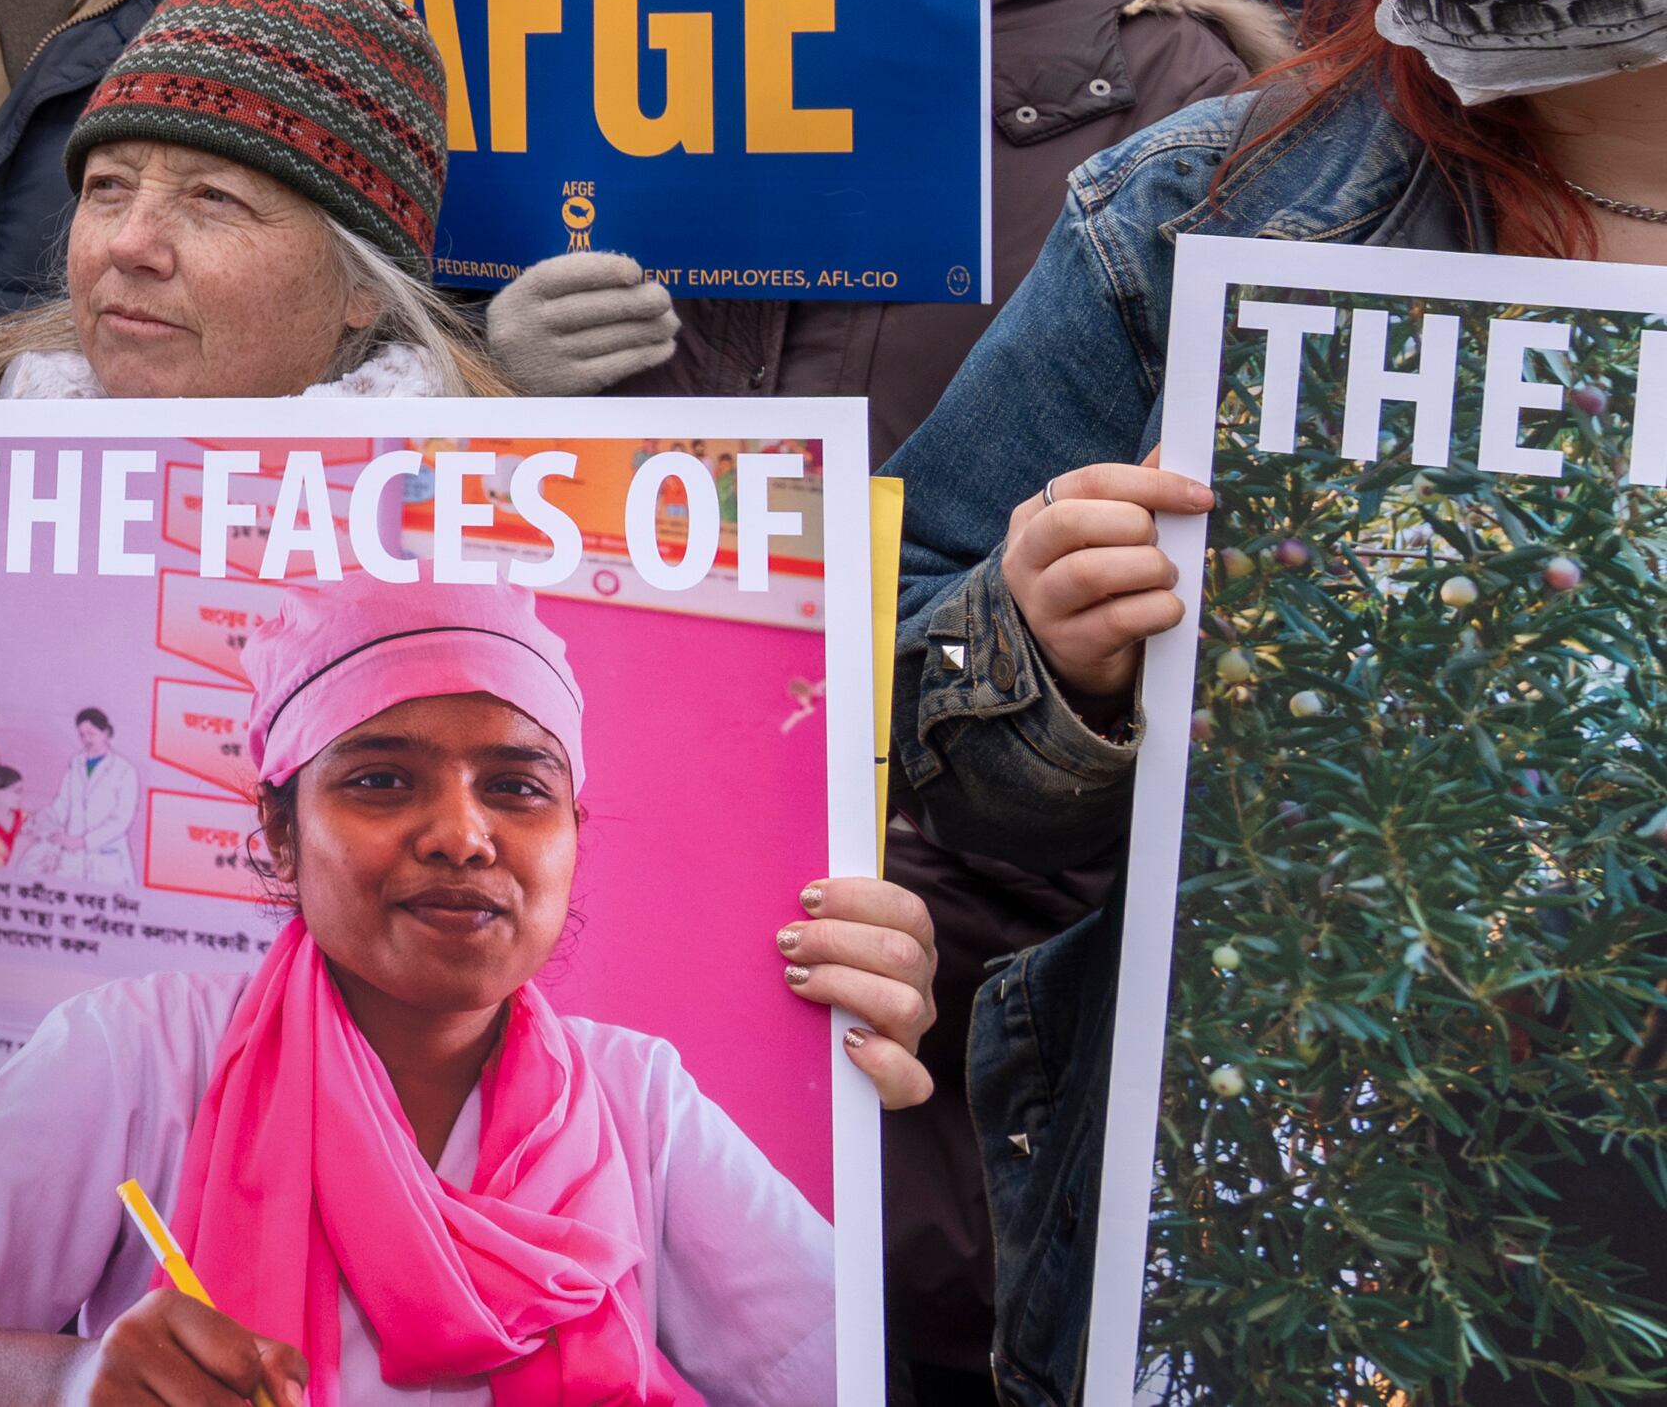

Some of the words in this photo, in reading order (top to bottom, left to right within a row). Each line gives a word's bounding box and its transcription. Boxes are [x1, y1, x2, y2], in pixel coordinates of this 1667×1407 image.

[562, 180, 595, 197] AFGE
[437, 258, 520, 280] FEDERATION
[688, 268, 811, 289] EMPLOYEES,
[816, 268, 898, 288] AFL-CIO
[1238, 300, 1571, 478] THE
[200, 450, 582, 587] FACES
[624, 450, 804, 592] OF
